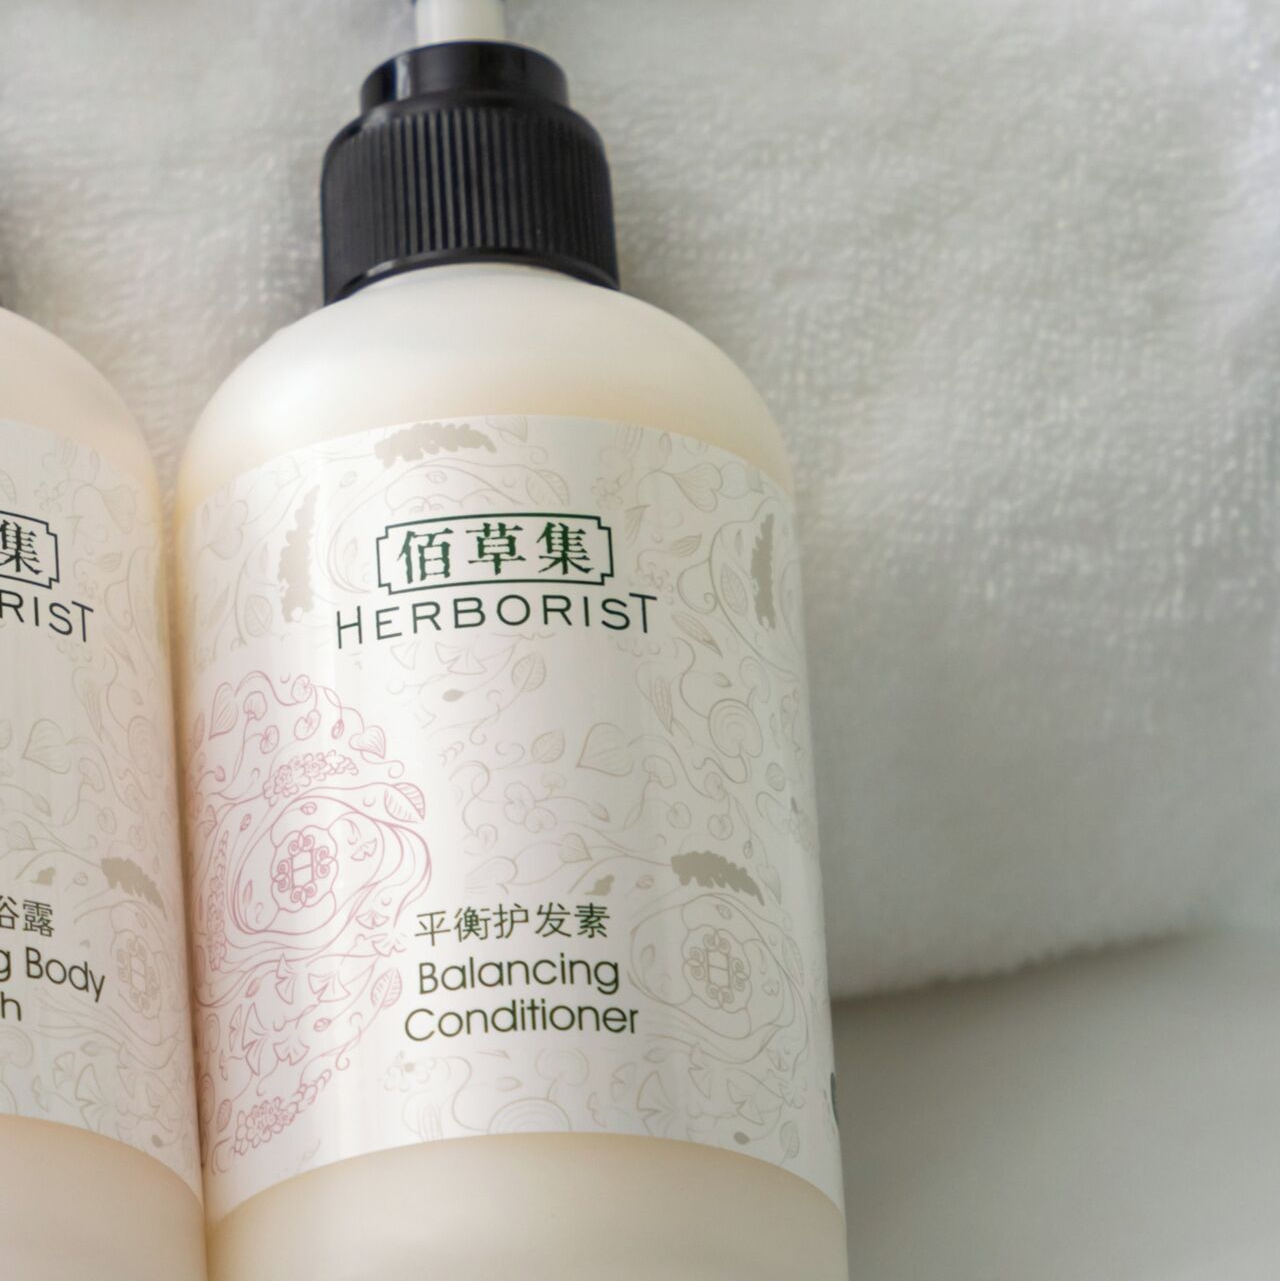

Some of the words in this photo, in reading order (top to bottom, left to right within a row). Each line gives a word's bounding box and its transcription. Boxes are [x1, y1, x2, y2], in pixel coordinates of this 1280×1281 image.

[398, 522, 594, 584] 佰草集
[336, 592, 657, 650] HERBORIST
[414, 902, 611, 946] 平衡护发素
[25, 948, 106, 1003] Body
[418, 952, 620, 996] Balancing
[404, 998, 639, 1042] Conditioner
